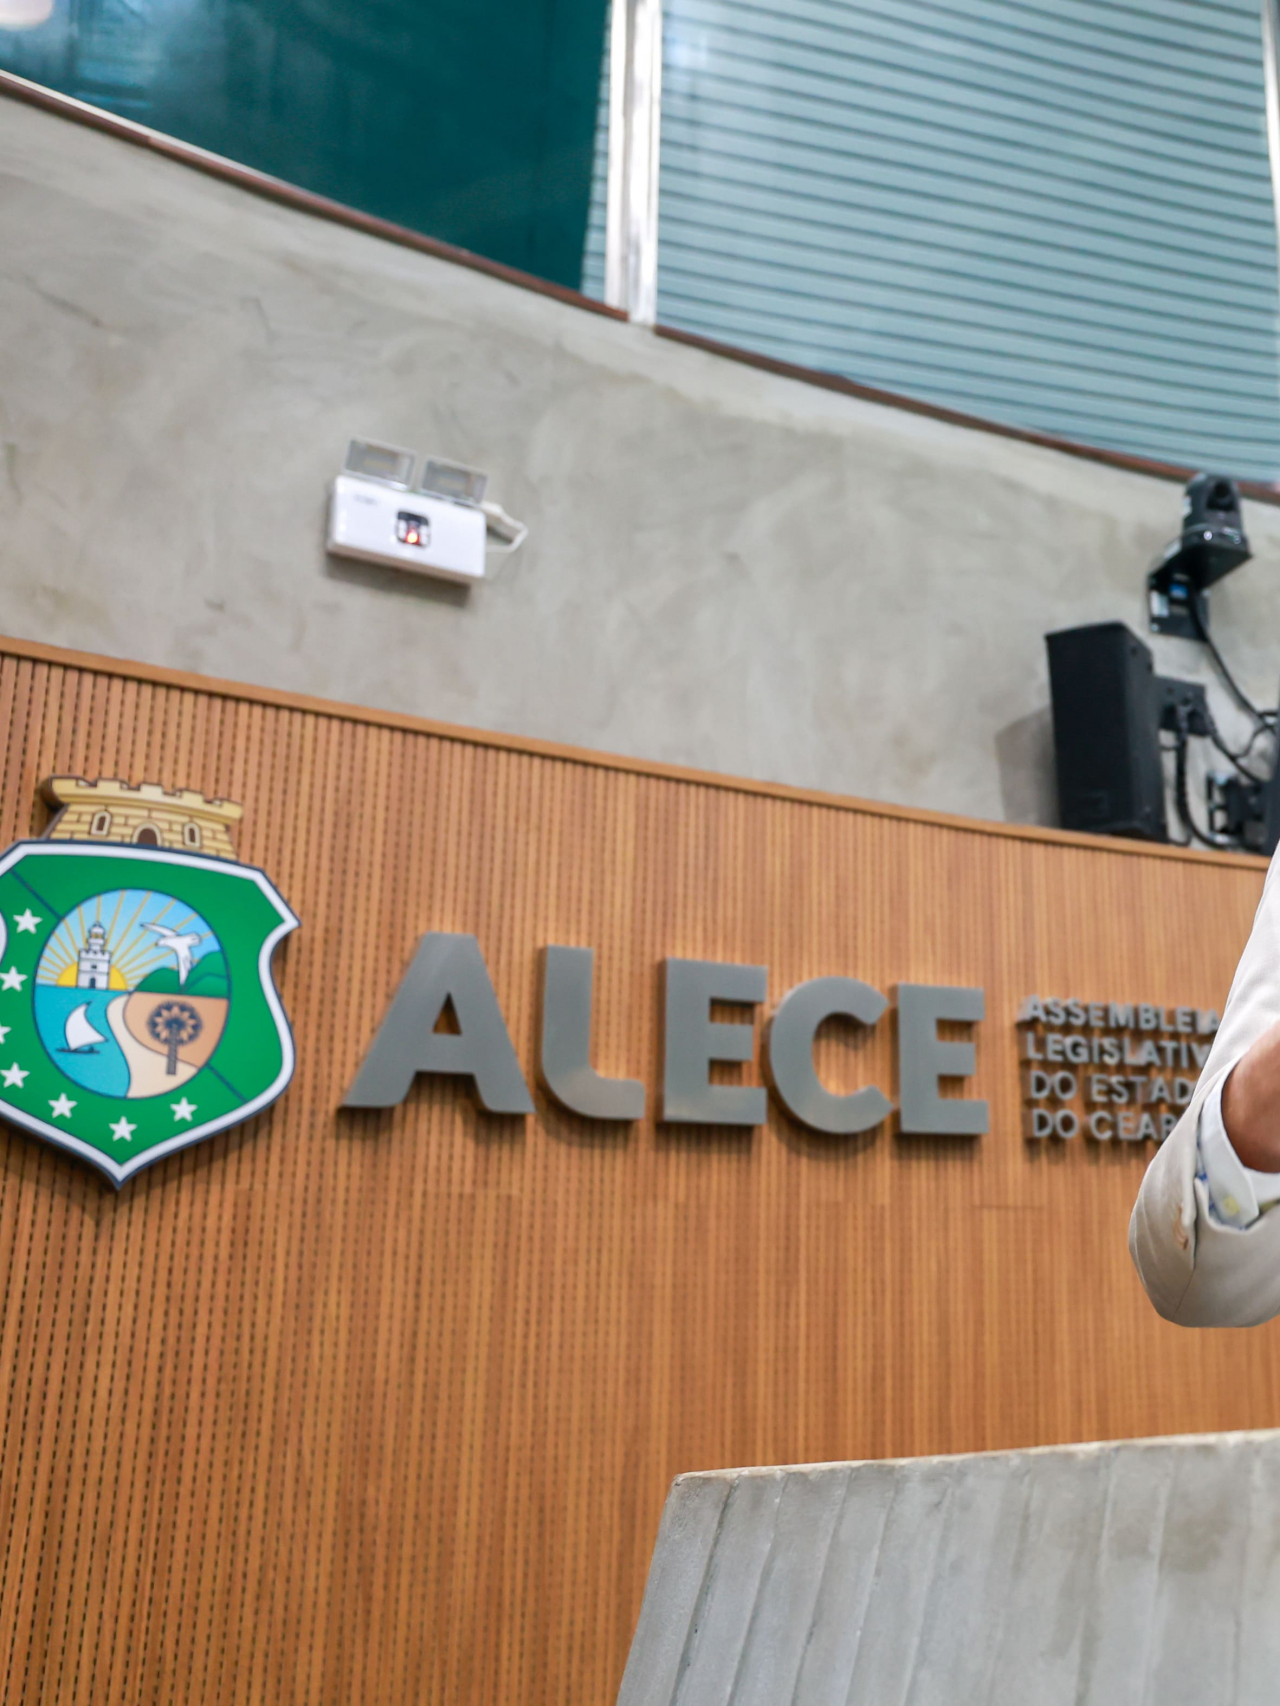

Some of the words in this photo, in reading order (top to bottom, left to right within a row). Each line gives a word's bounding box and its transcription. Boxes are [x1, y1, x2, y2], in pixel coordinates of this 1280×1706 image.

[338, 930, 990, 1135] ALECE
[1017, 994, 1221, 1035] ASSEMBLEIA
[1026, 1031, 1212, 1069] LEGISLATIV
[1029, 1069, 1078, 1101] DO
[1090, 1073, 1198, 1105] ESTAD
[1031, 1107, 1080, 1139] DO
[1089, 1110, 1179, 1141] CEAR
